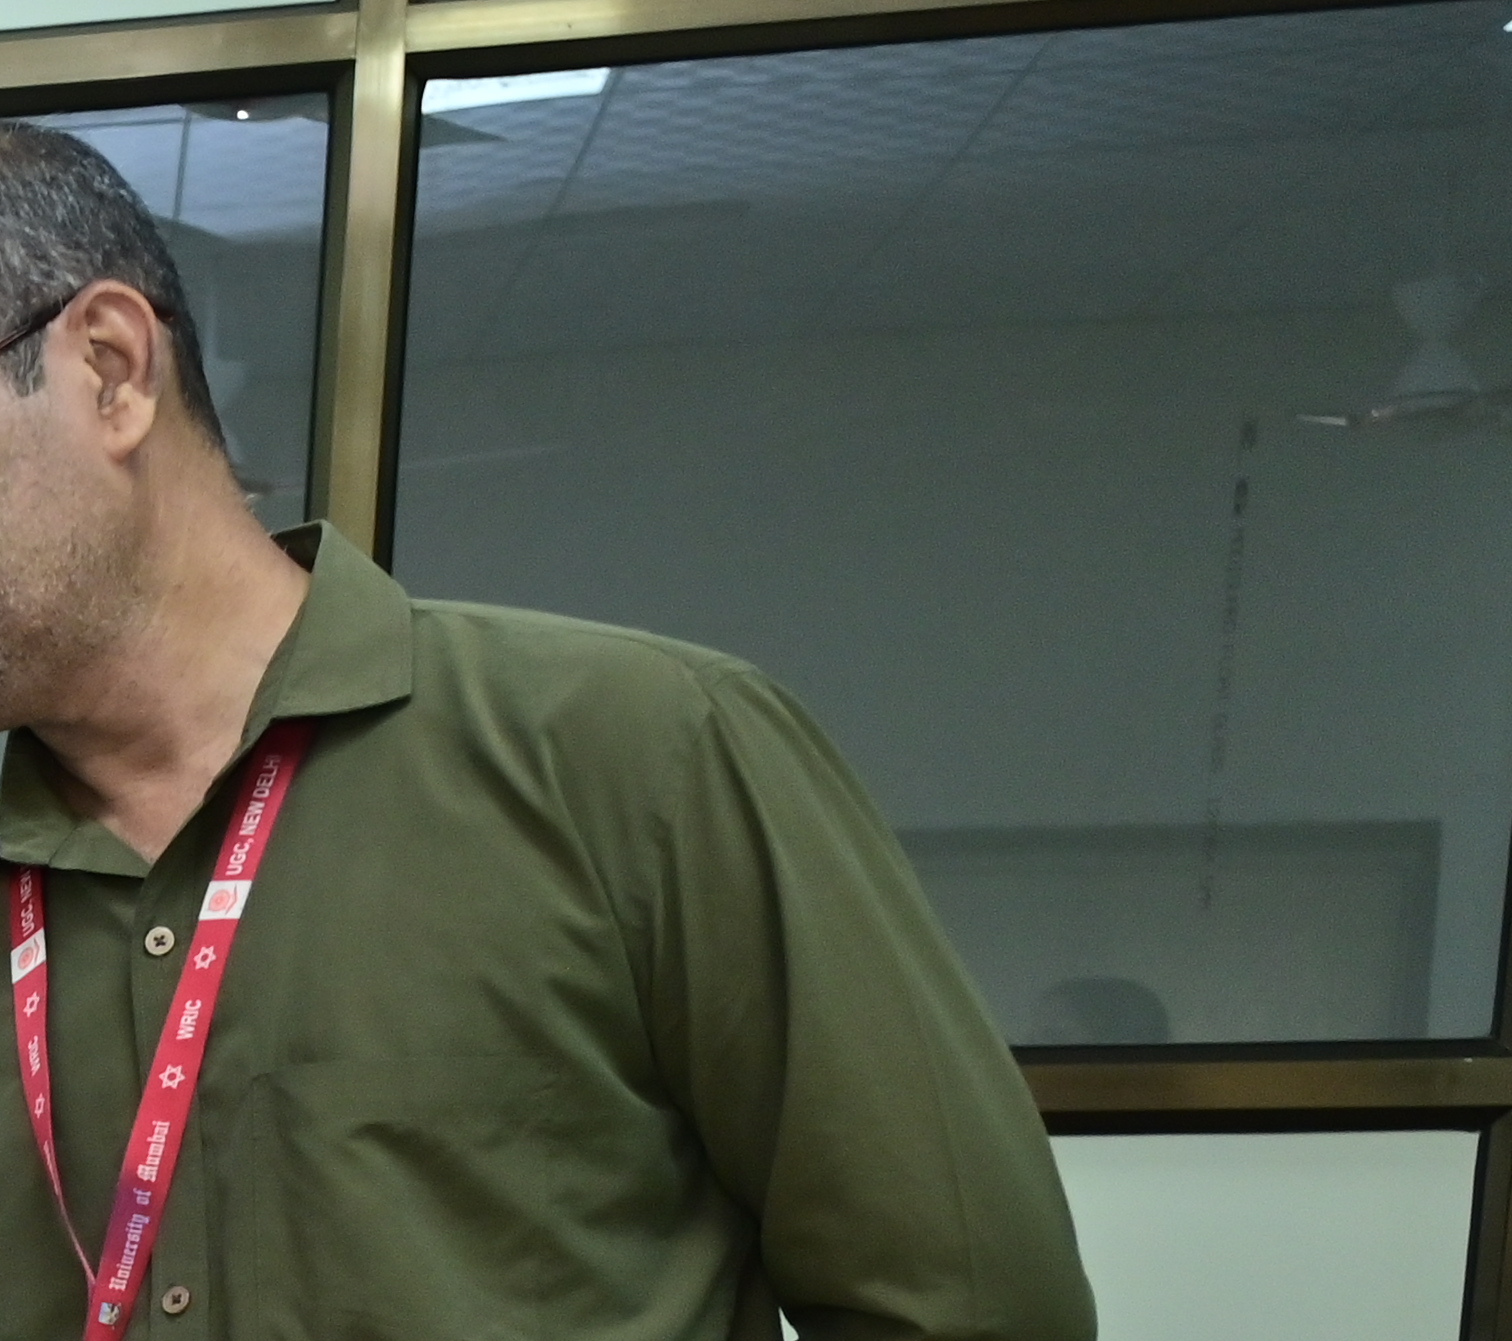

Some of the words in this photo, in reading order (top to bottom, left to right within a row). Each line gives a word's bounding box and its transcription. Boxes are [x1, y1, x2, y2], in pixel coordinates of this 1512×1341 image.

[238, 800, 266, 836] NEW
[176, 999, 202, 1040] WRIC
[133, 1187, 152, 1206] of
